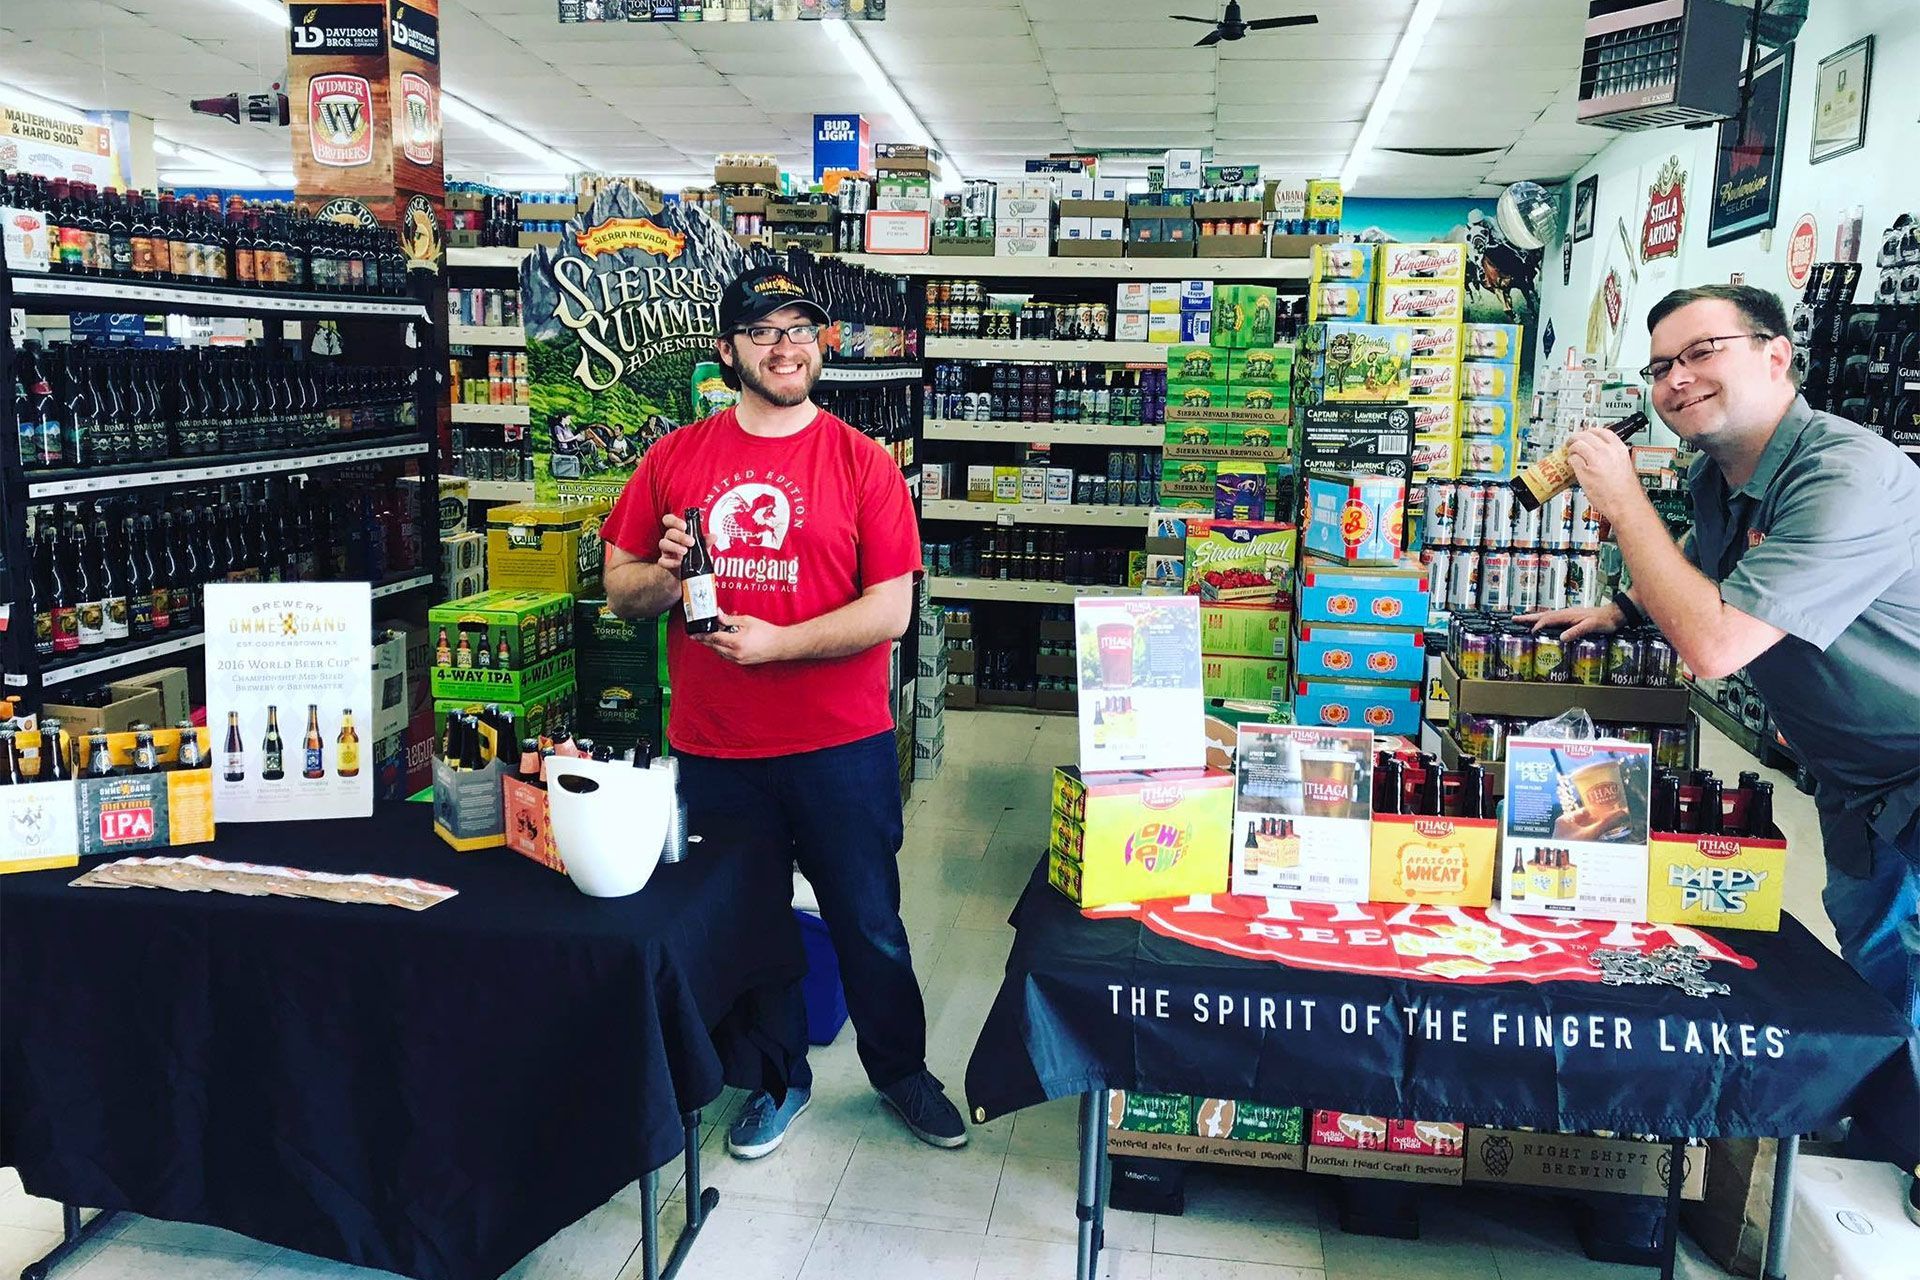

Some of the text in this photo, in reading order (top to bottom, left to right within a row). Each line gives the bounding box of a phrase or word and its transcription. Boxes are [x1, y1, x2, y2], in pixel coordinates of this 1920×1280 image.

[326, 28, 378, 37] DAVIDSON
[408, 28, 435, 47] DAVIDSON
[326, 38, 353, 47] BROS.
[314, 80, 363, 97] WIDMER
[5, 109, 84, 136] MALTERNATIVES
[824, 120, 850, 131] BUD
[12, 123, 79, 146] & HARD SODA
[99, 133, 107, 149] 5
[818, 130, 855, 141] LIGHT
[1149, 171, 1164, 182] JAM
[1222, 168, 1242, 176] MAGIC
[320, 200, 352, 222] HOCK
[1651, 197, 1678, 224] STELLA
[593, 230, 668, 248] SIERRA NEVADA
[1648, 220, 1676, 248] ARTOIS
[553, 256, 721, 329] SIERRA
[1831, 314, 1841, 343] GUINNESS
[624, 336, 719, 376] ADVENTUR
[1827, 356, 1837, 384] GUINNESS
[1868, 360, 1890, 374] GUINNESS
[1900, 367, 1920, 378] GUIN
[1177, 409, 1201, 417] SIERRA
[1203, 411, 1230, 419] NEVADA
[1231, 412, 1263, 420] BREWING
[1307, 409, 1388, 420] CAPTAIN LAWRENCE
[1893, 430, 1920, 440] GUINN
[1175, 447, 1200, 455] SIERRA
[1202, 448, 1229, 456] NEVADA
[1230, 449, 1262, 457] BREWING
[1304, 459, 1385, 470] CAPTAIN LAWRENCE
[557, 485, 573, 493] TELL
[585, 486, 603, 494] YOUR
[971, 482, 991, 492] PORTER
[558, 494, 595, 506] TEXT
[699, 470, 806, 529] LIMITED EDITION
[1655, 502, 1686, 511] arlsberg
[1192, 535, 1291, 568] Strawberry
[711, 555, 799, 584] omegang
[715, 582, 776, 592] ABORATION
[252, 600, 323, 614] BREWERY
[596, 627, 633, 636] TORPEDO
[256, 640, 323, 648] COOPERSTOWN
[218, 659, 245, 671] 2016
[479, 656, 490, 664] IPA
[1538, 656, 1564, 664] NATION
[438, 669, 513, 684] 4-WAY IPA
[521, 654, 574, 687] 4-WAY IPA
[1551, 672, 1569, 682] MOS
[1646, 674, 1667, 686] OSAIC
[599, 710, 636, 719] TORPEDO
[1290, 730, 1320, 741] ITHACA
[1563, 744, 1594, 754] ITHACA
[1516, 762, 1555, 773] HAPPY
[1521, 772, 1548, 783] PILS
[1140, 786, 1184, 800] ITHACA
[1304, 782, 1349, 799] ITHACA
[104, 813, 150, 838] IPA
[1414, 820, 1455, 833] ITHACA
[1696, 840, 1741, 854] ITHACA
[1407, 857, 1460, 865] APRICOT
[1406, 865, 1460, 883] WHEAT
[1668, 864, 1768, 891] HAPPY
[1681, 889, 1748, 915] PILS
[1247, 922, 1389, 946] BEE
[1107, 984, 1170, 1018] THE
[1193, 993, 1316, 1031] SPIRIT
[1340, 1003, 1381, 1036] OF
[1403, 1006, 1468, 1042] THE
[1493, 1013, 1634, 1051] FINGER
[1317, 1130, 1343, 1138] Dogfish
[1323, 1134, 1345, 1143] Head
[1151, 1141, 1172, 1151] ales
[1177, 1143, 1191, 1153] for
[1196, 1146, 1256, 1159] off-centered
[1523, 1143, 1649, 1166] NIGHT SHIFT
[1310, 1155, 1462, 1177] Dogfish Head Craft Brewery
[1542, 1163, 1627, 1180] BREWING
